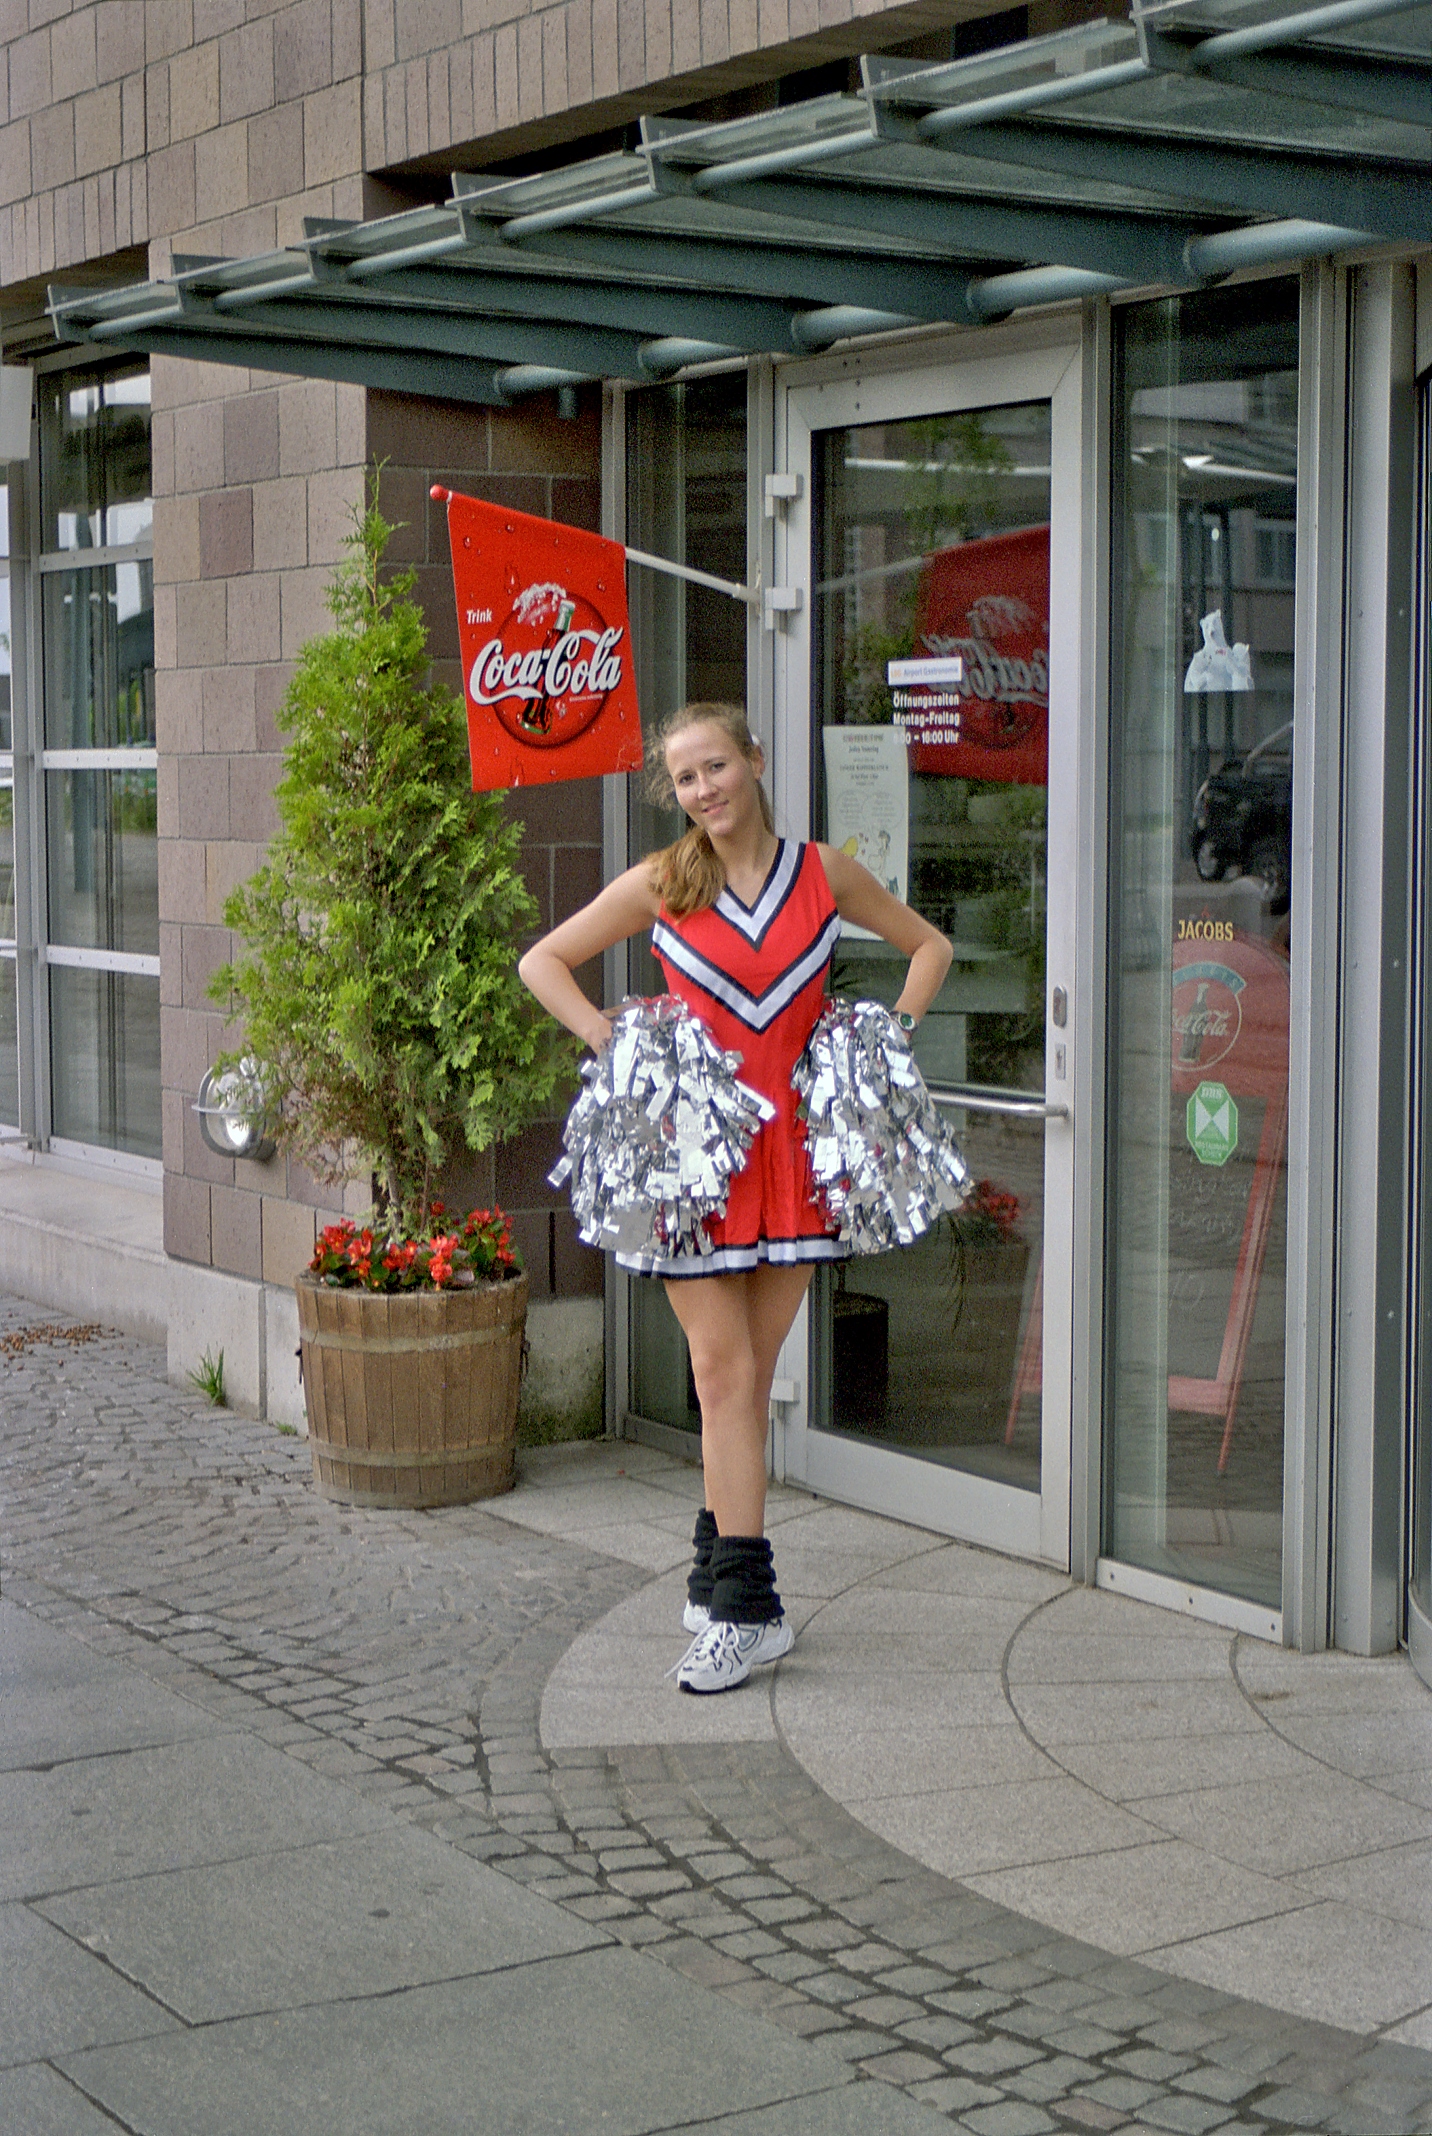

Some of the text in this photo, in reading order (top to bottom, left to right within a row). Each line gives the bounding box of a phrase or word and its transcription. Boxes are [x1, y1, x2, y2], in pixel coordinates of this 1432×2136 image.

[466, 608, 493, 625] Trink
[469, 626, 624, 705] Coca-Cola
[893, 691, 960, 709] Öffnungszeiten
[893, 711, 960, 728] Montag-Freitag
[944, 729, 960, 744] Uhr
[1178, 919, 1234, 942] JACOBS
